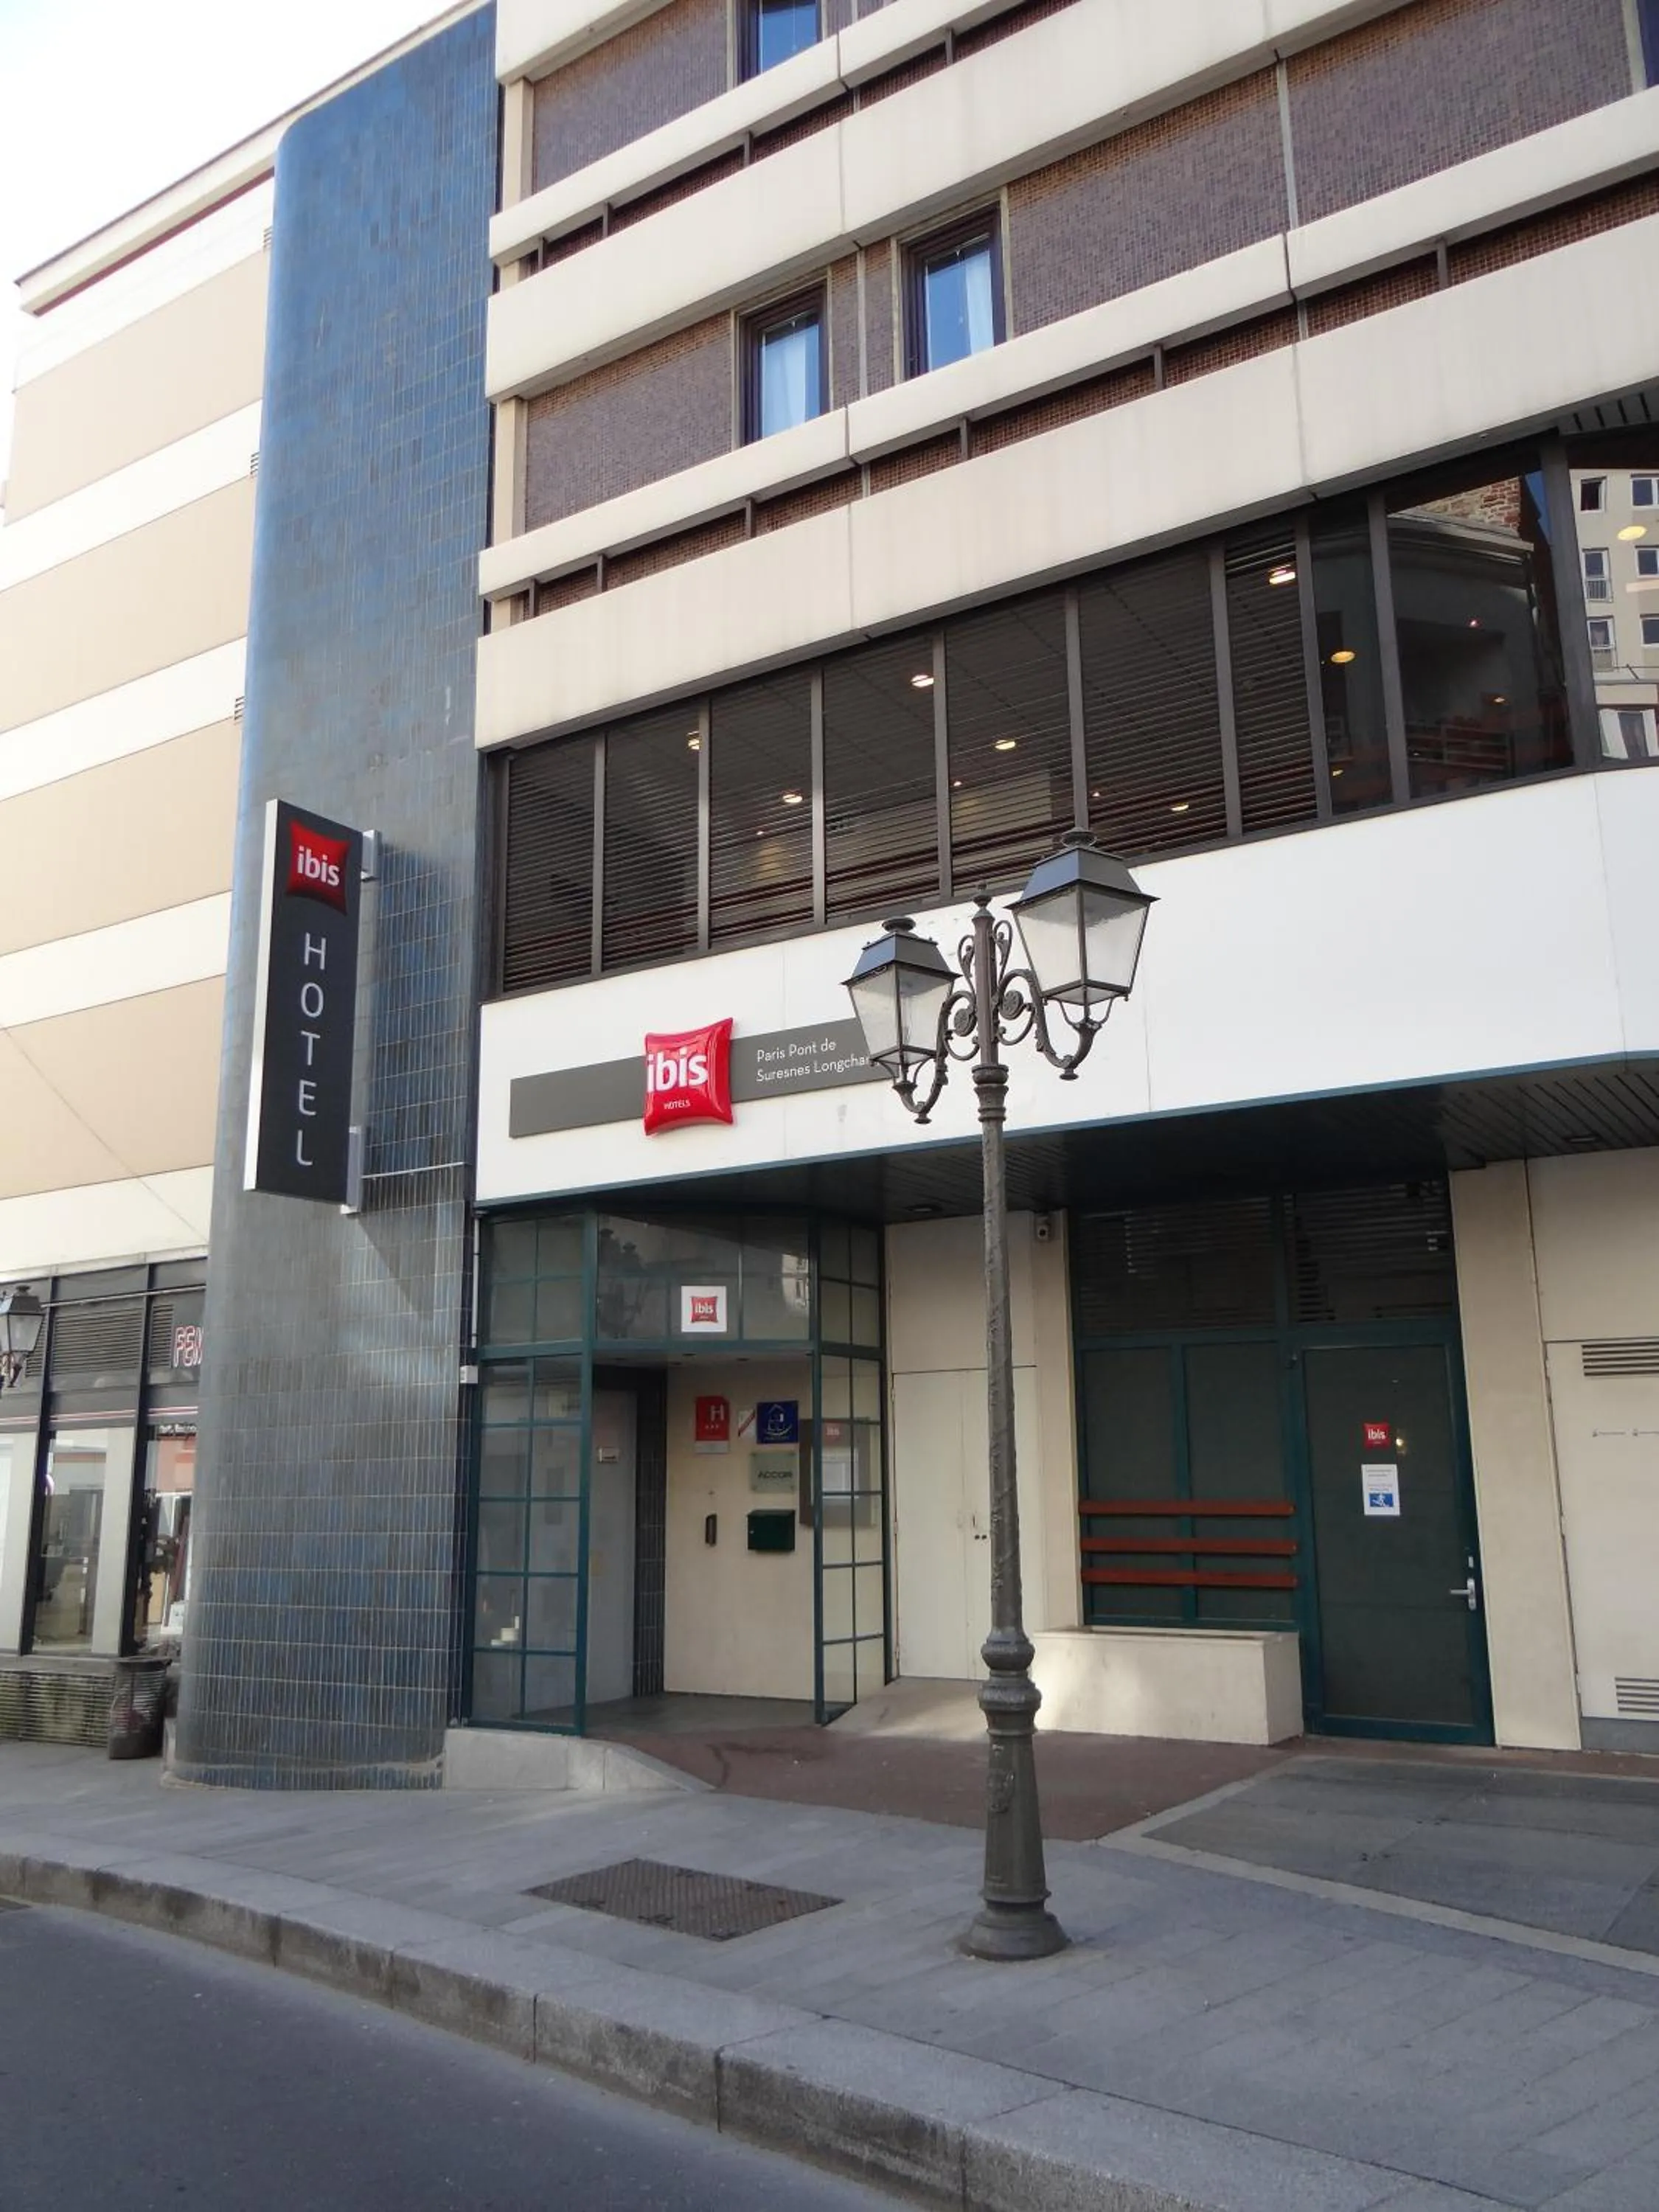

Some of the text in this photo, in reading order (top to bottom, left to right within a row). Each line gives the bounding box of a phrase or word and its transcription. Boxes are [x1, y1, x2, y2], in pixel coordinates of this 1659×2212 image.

[297, 845, 340, 886] ibis
[296, 932, 327, 1167] HOTEL
[757, 1038, 837, 1062] Paris Pont de
[647, 1047, 709, 1093] ibis
[756, 1065, 810, 1082] Suresnes
[664, 1099, 691, 1110] HOTELS
[695, 1302, 714, 1314] ibis
[710, 1404, 725, 1422] H
[1368, 1428, 1386, 1440] ibis
